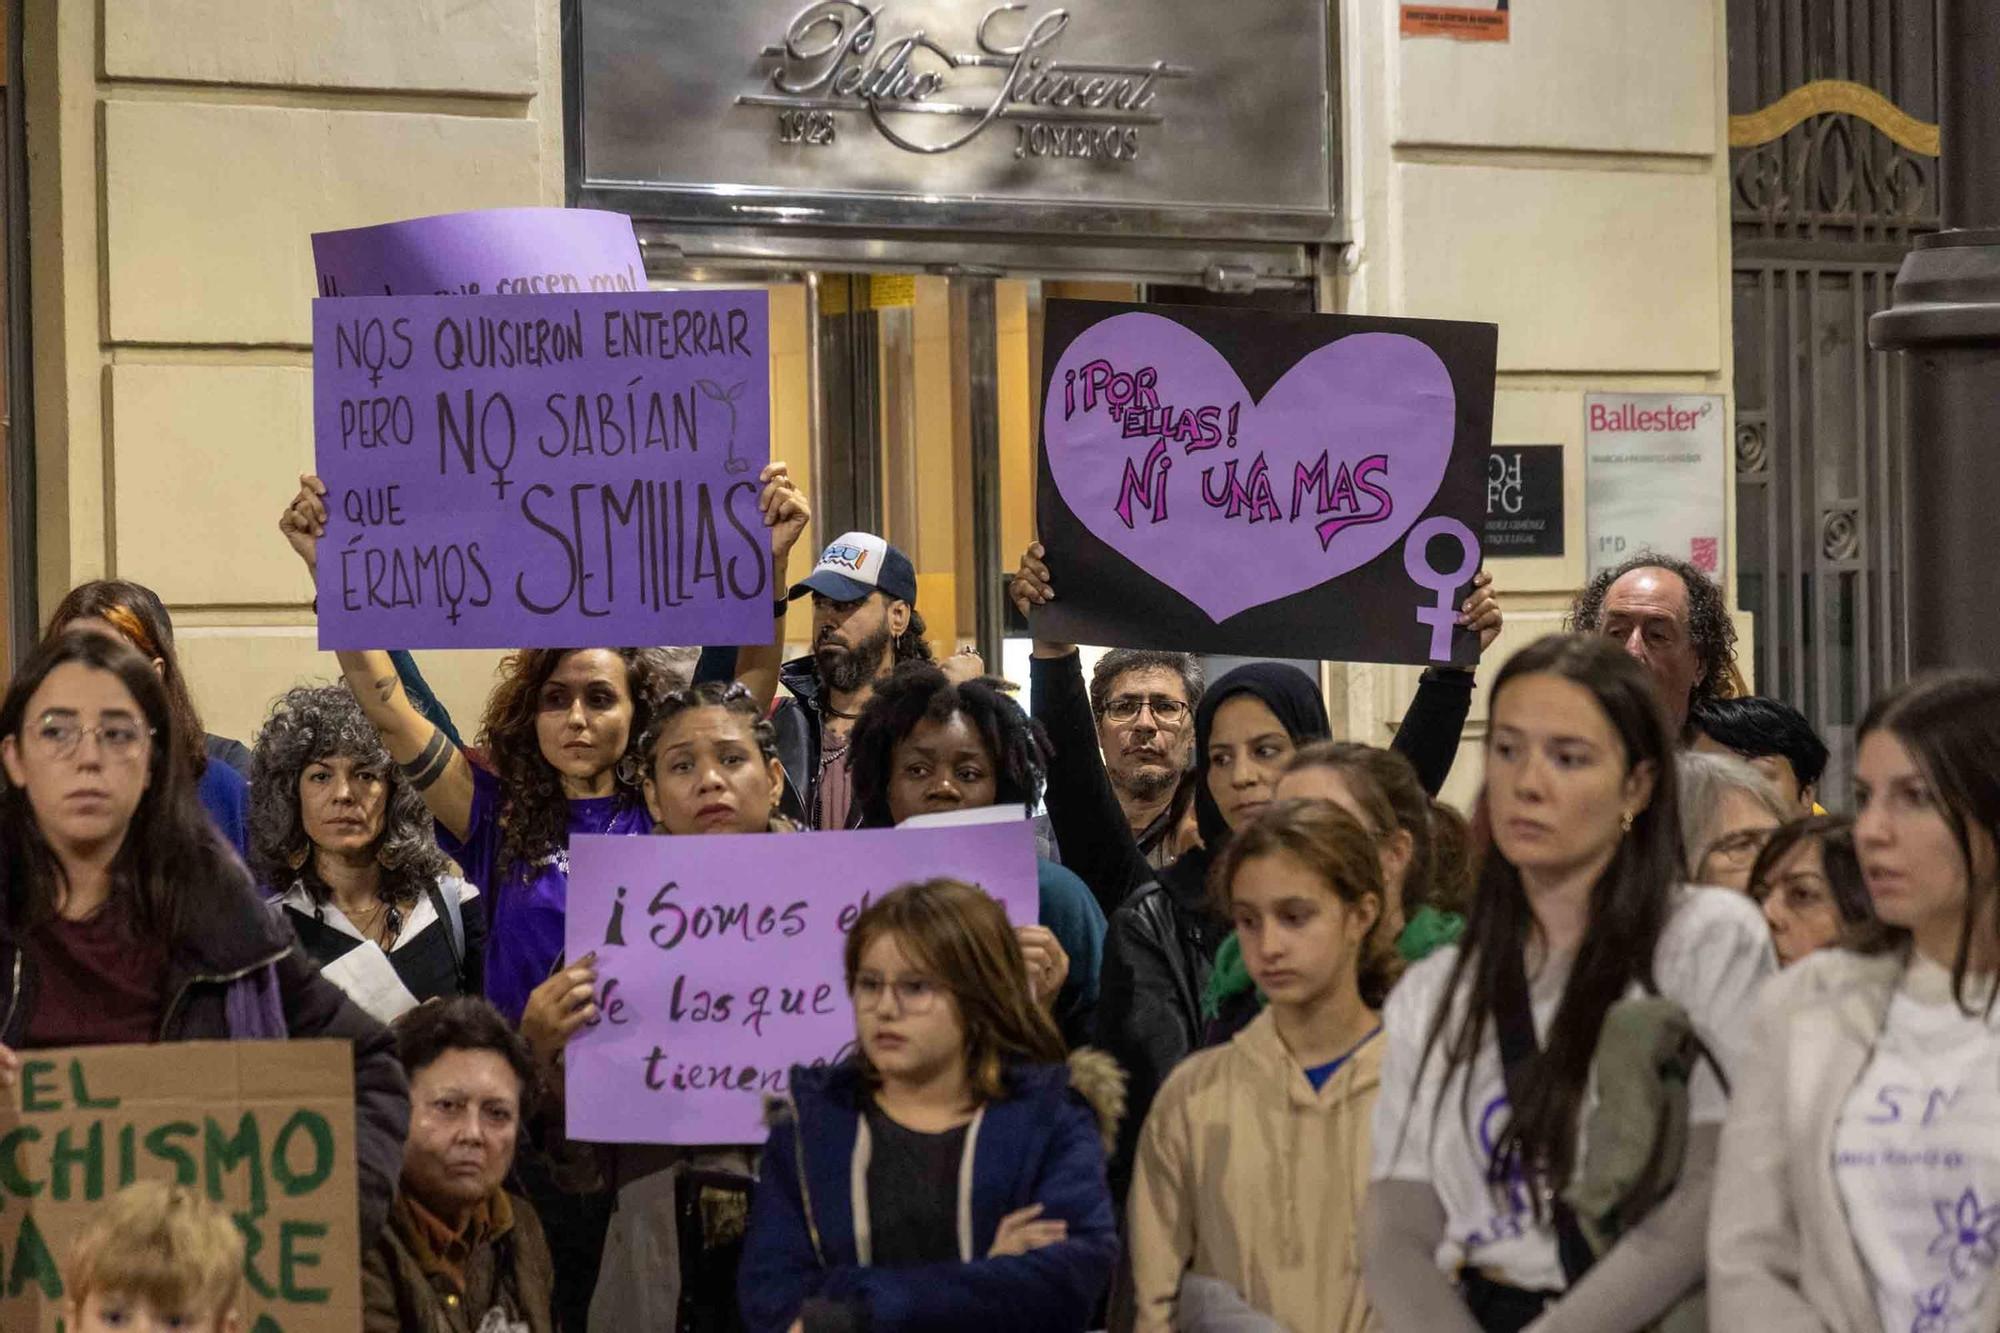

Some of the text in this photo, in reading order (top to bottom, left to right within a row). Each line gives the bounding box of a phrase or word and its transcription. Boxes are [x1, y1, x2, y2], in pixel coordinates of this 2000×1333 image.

[777, 110, 836, 145] 1928
[1014, 122, 1140, 160] JOYEROS
[336, 309, 752, 387] NOS QUISIERON ENTERRAR
[340, 375, 699, 500] PERO NO SABÍAN
[1121, 400, 1240, 455] ELLAS!
[1590, 403, 1699, 433] Ballester
[1201, 450, 1282, 525] UNA
[1289, 448, 1394, 553] MAS
[344, 479, 767, 617] QUE SEMILLAS
[340, 533, 493, 626] ÉRAMOS
[669, 974, 733, 1022] las
[742, 982, 834, 1037] que
[22, 1057, 121, 1113] EL
[644, 1046, 790, 1092] tienen
